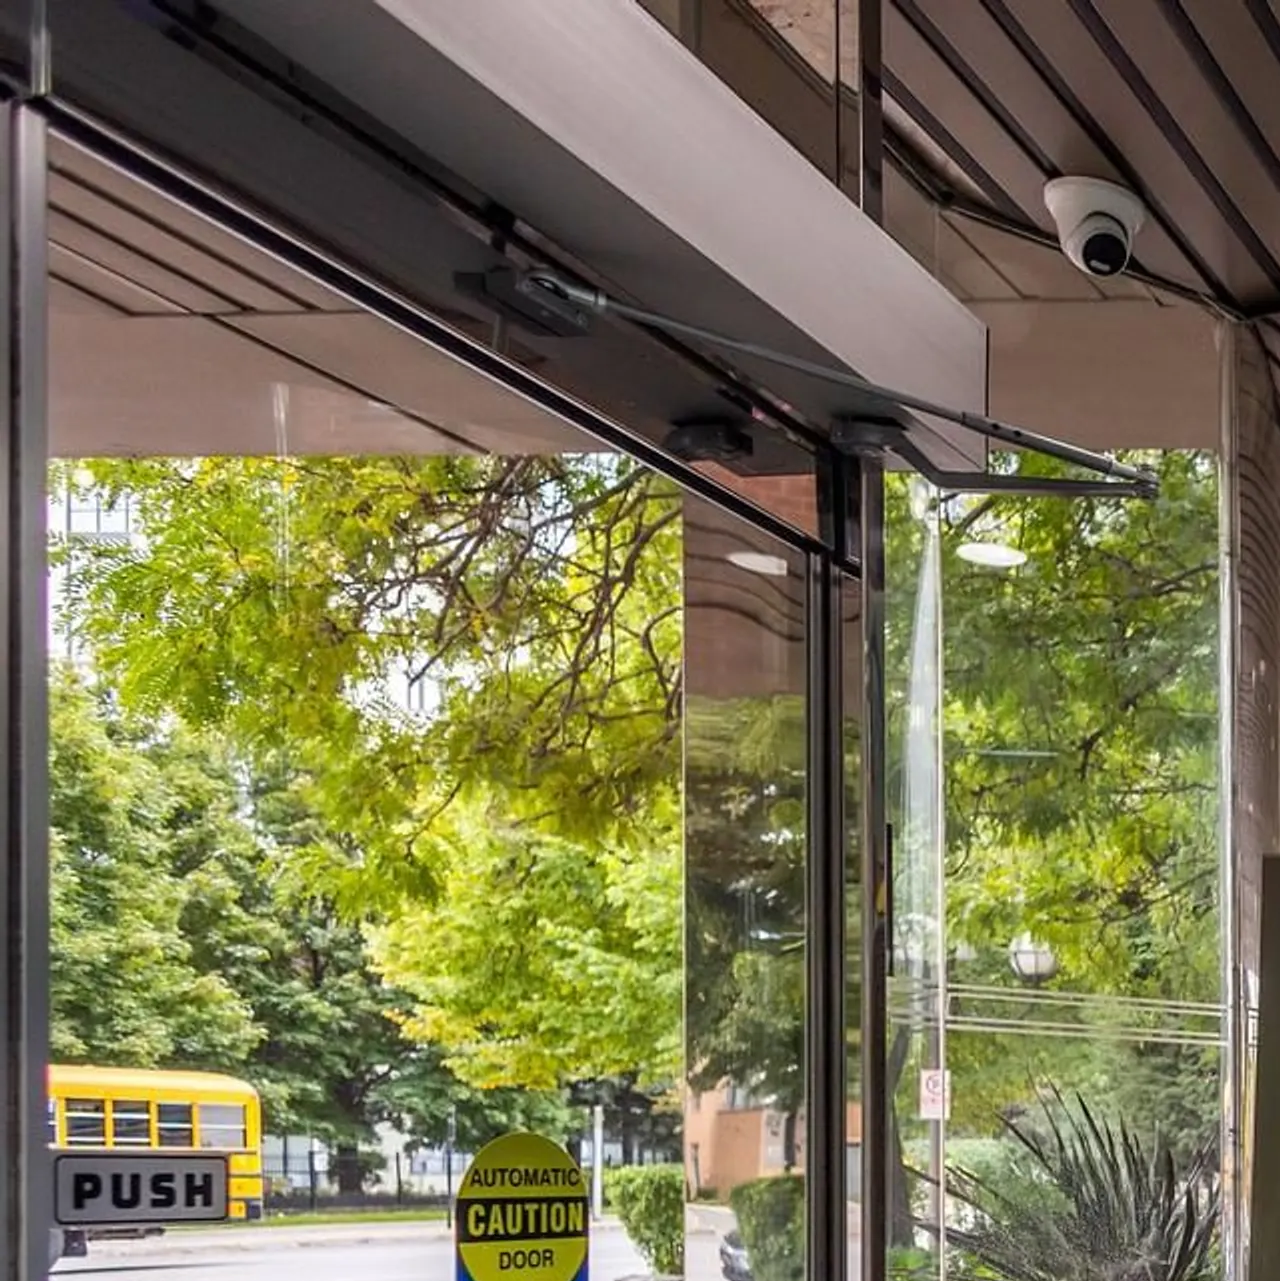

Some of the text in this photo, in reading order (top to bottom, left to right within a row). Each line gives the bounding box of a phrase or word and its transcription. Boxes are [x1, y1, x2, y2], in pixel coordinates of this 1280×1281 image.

[73, 1172, 213, 1210] PUSH
[470, 1168, 581, 1188] AUTOMATIC
[467, 1202, 584, 1237] CAUTION
[499, 1249, 554, 1270] DOOR
